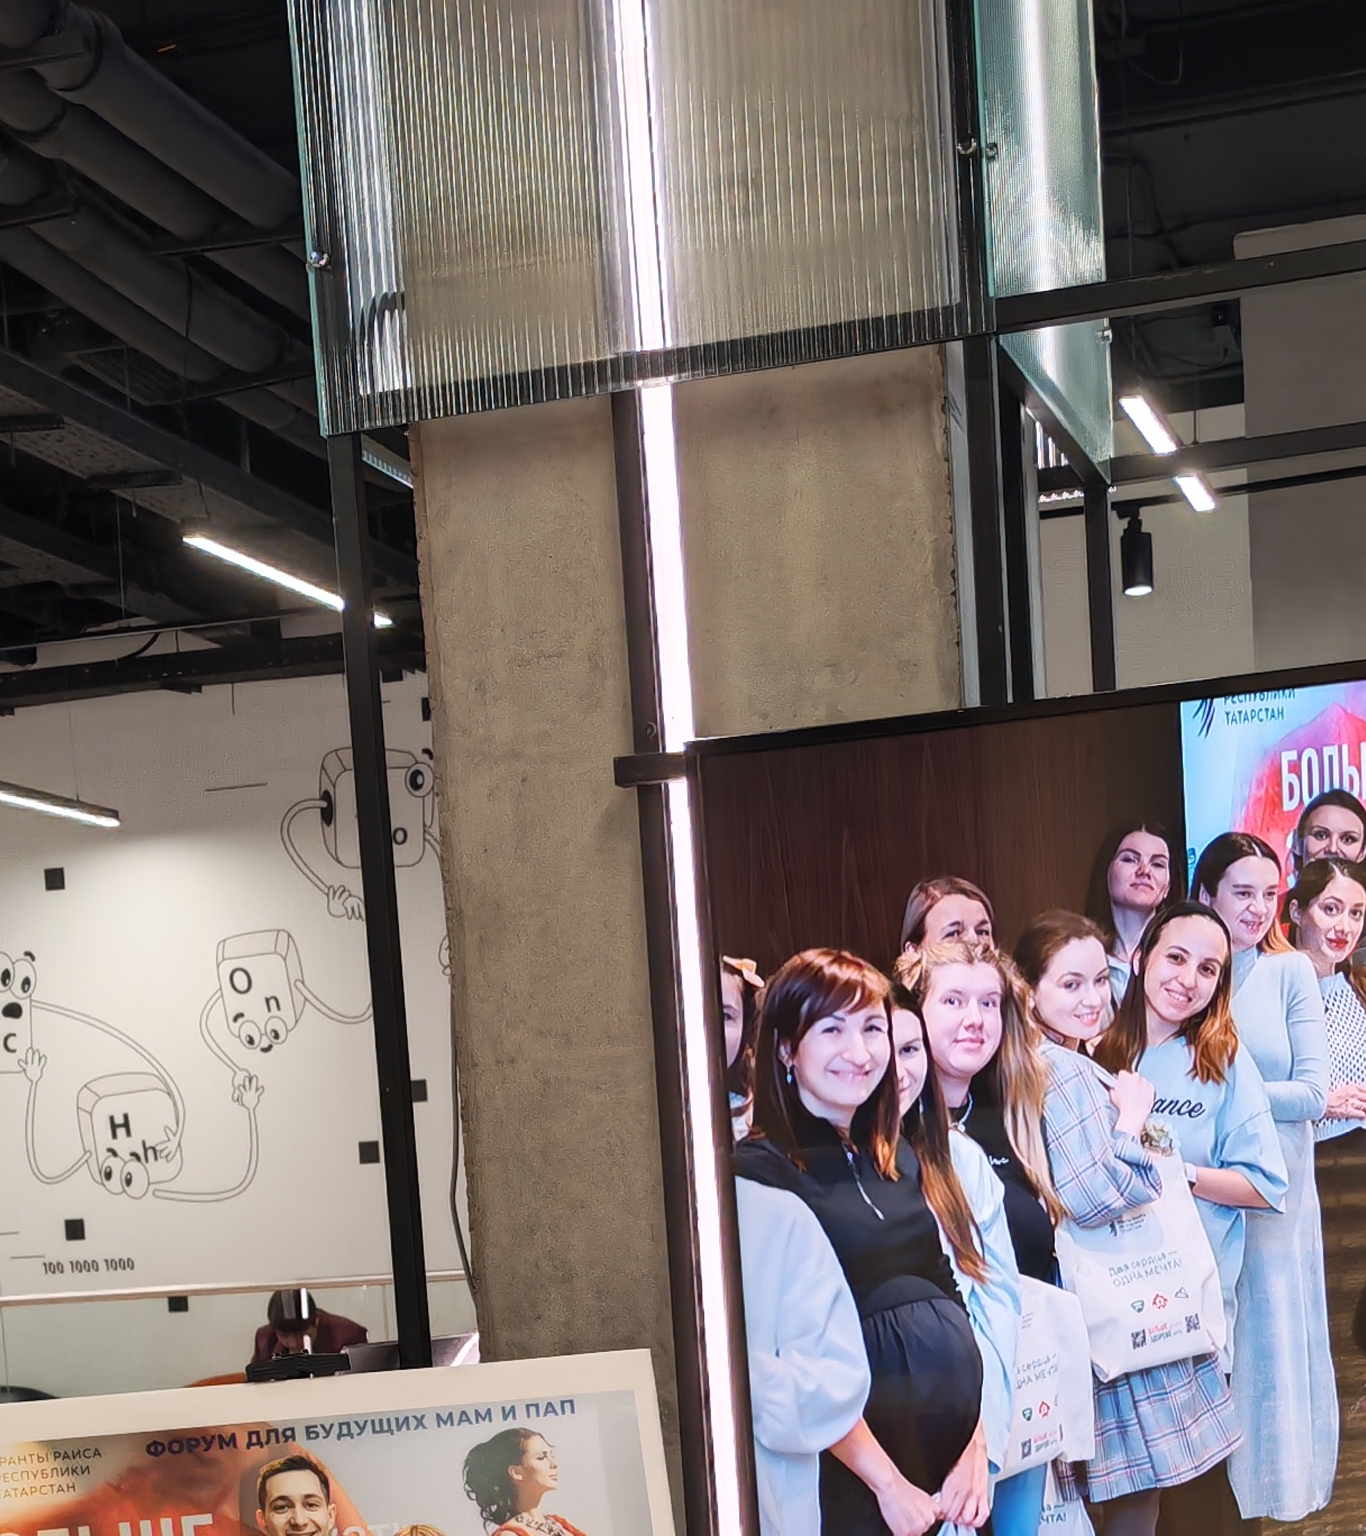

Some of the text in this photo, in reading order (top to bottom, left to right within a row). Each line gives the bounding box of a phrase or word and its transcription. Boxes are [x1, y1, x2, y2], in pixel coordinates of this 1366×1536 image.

[1225, 707, 1285, 726] ТАТАРСТАН
[43, 1257, 135, 1275] 100 1000 1000
[145, 1398, 577, 1460] ФОРУМ ДЛЯ БУДУЩИХ МАМ ПАП
[53, 1446, 102, 1463] РАИСА
